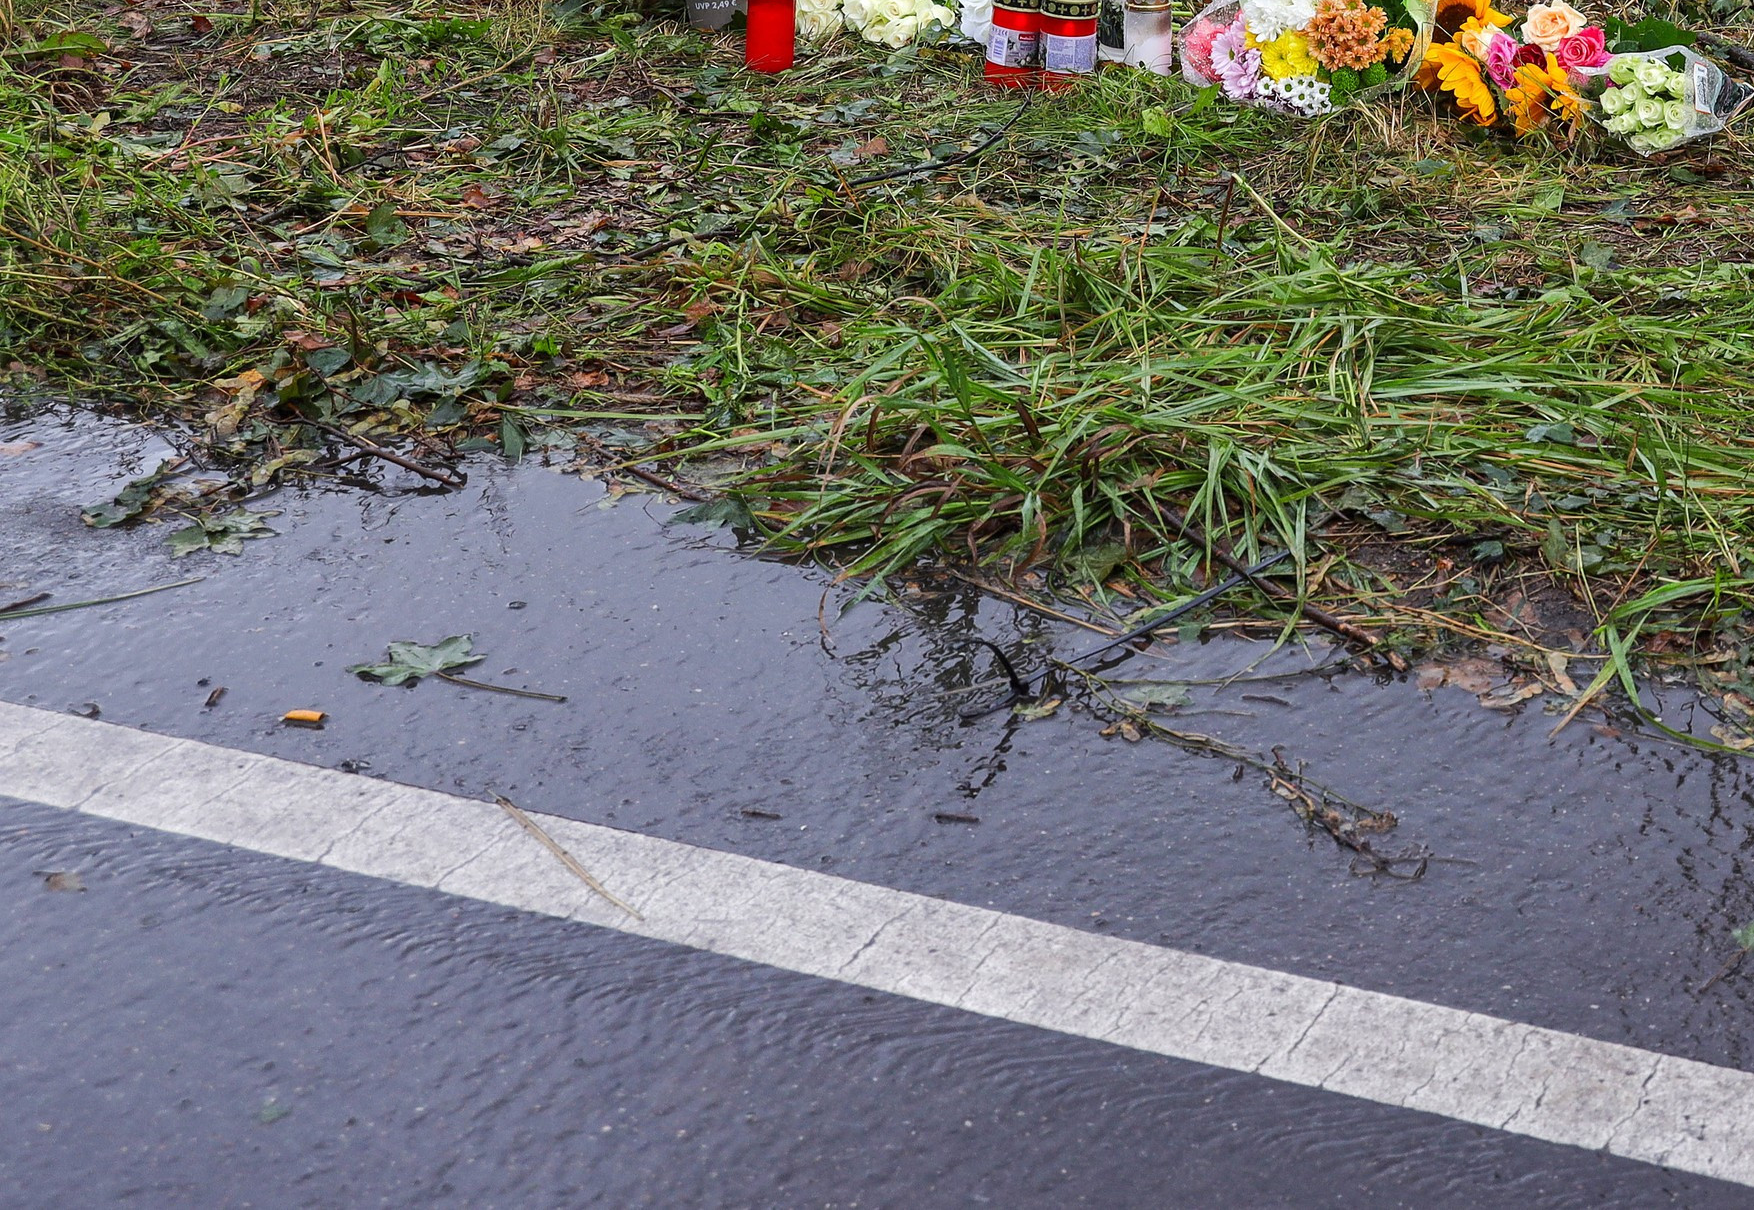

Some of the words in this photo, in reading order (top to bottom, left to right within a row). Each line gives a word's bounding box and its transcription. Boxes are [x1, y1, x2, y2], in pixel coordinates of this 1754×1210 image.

[695, 2, 710, 10] UVP
[711, 0, 730, 10] 2,49
[731, 0, 737, 7] €
